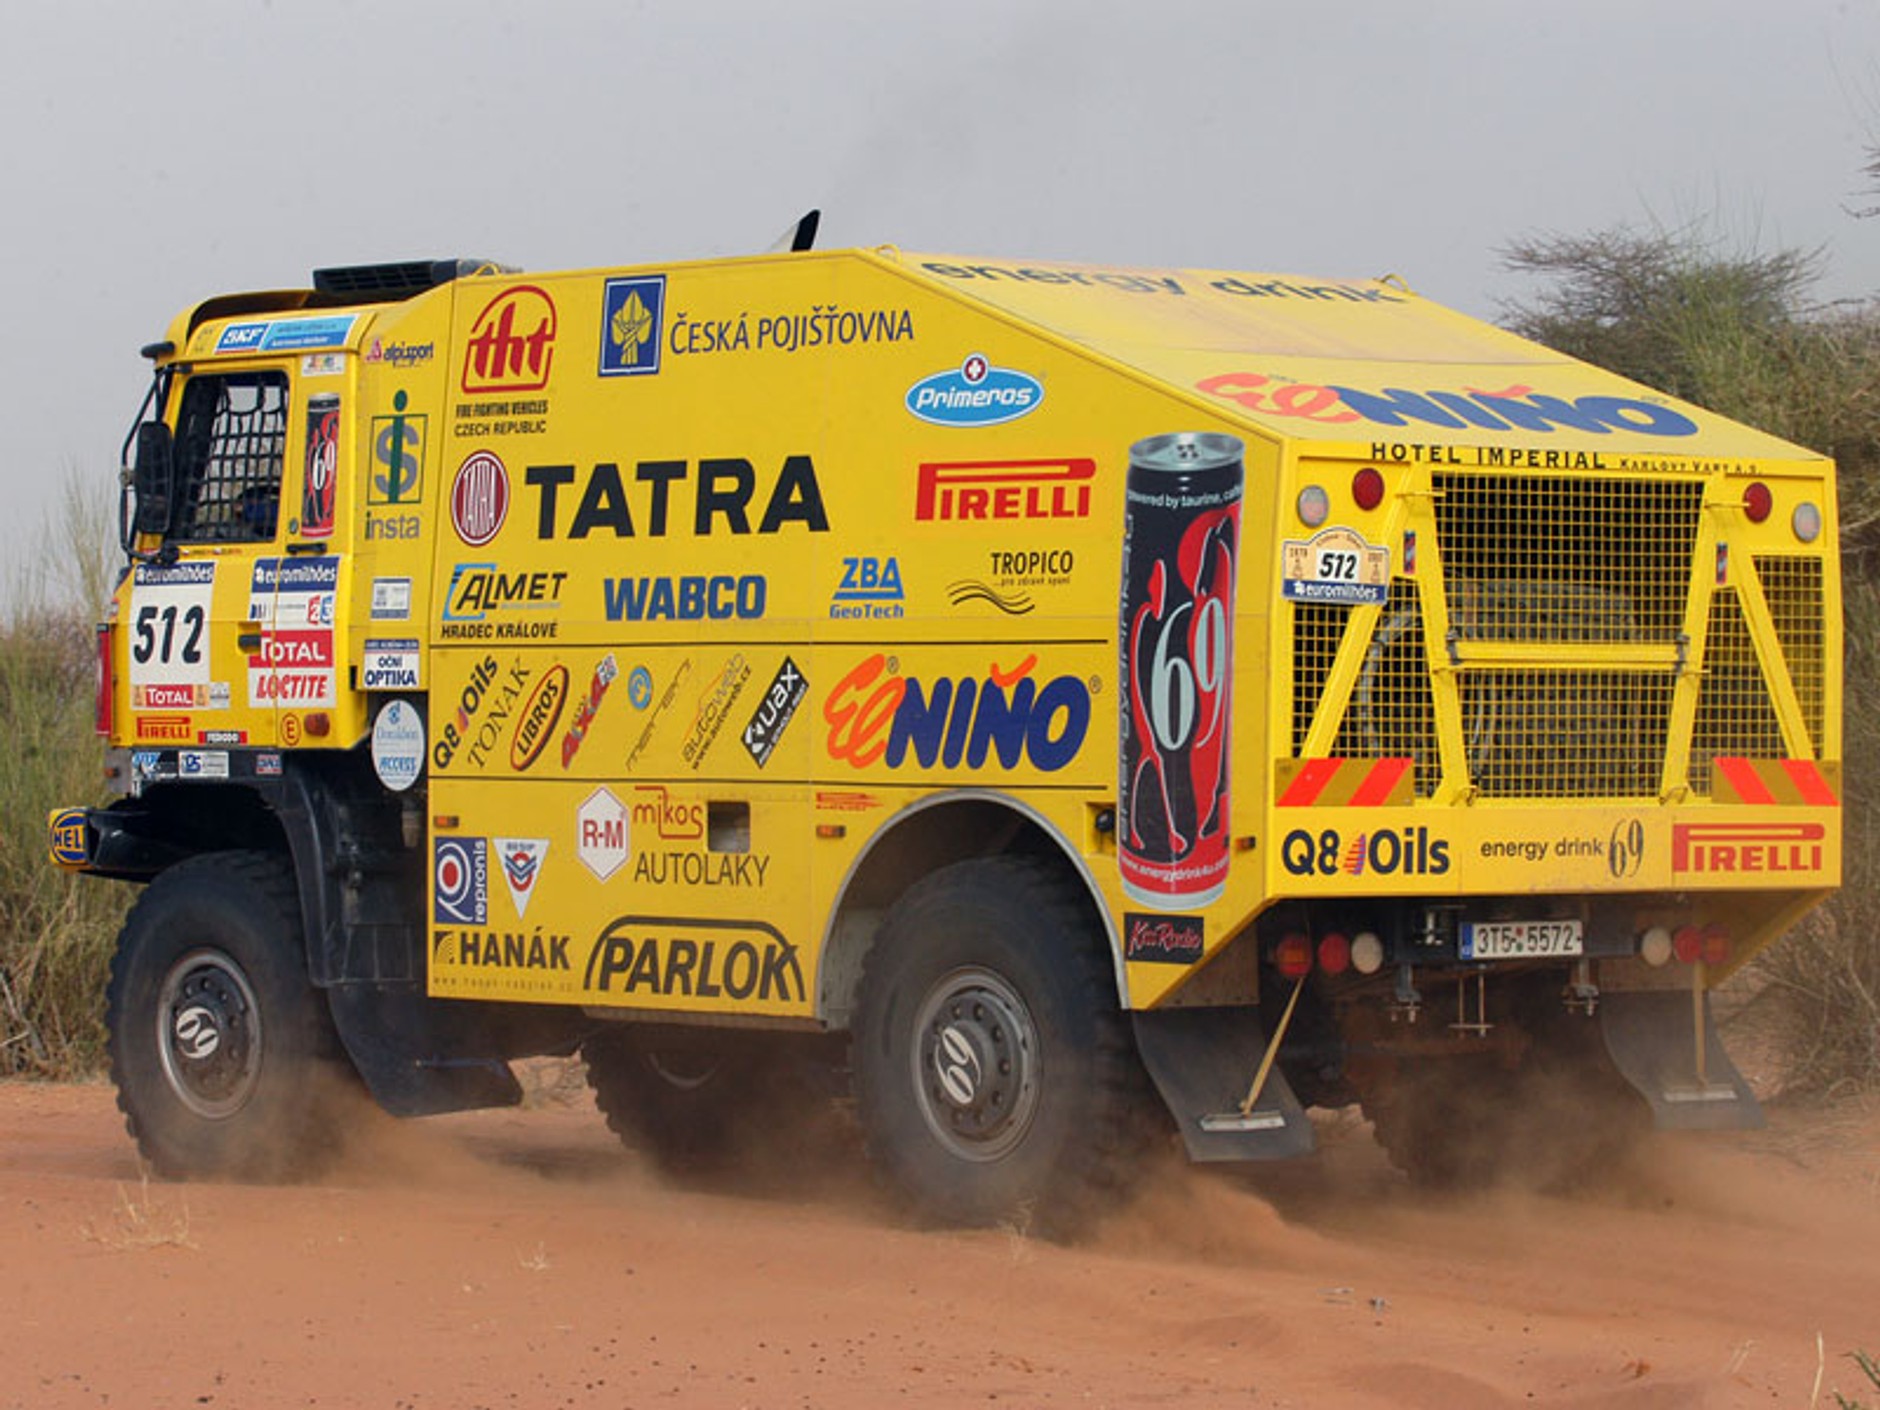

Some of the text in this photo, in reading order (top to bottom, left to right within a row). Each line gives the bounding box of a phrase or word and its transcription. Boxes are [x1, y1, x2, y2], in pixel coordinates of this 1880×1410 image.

[921, 263, 1408, 303] energy drink
[223, 328, 264, 345] SKF
[669, 305, 914, 354] ČESKÁ POJIŠŤOVNA
[916, 384, 1034, 410] Primeros
[454, 419, 547, 438] CZECH REPUBLIC
[1371, 442, 1461, 465] HOTEL
[1477, 445, 1606, 471] IMPERIAL
[525, 454, 830, 540] TATRA
[915, 458, 1096, 521] PIRELLI
[365, 511, 420, 540] insta
[990, 550, 1073, 575] TROPICO
[1319, 551, 1358, 579] 512
[456, 572, 567, 610] ALMET
[603, 575, 767, 621] WABCO
[441, 618, 558, 639] HRADEC KRÁLOVÉ
[829, 602, 905, 620] GeoTech
[133, 604, 204, 664] 512
[261, 637, 327, 662] TOTAL
[256, 674, 328, 699] LOCTITE
[365, 669, 417, 686] OPTIKA
[1151, 597, 1226, 750] 69
[148, 688, 193, 704] TOTAL
[433, 654, 498, 770] Q8 Oils
[467, 657, 530, 768] TONAK
[136, 716, 191, 738] PIRELLI
[516, 679, 559, 756] LIBROS
[633, 786, 704, 840] mikos
[583, 819, 624, 849] R-M
[1281, 827, 1450, 876] Q8 Oils
[1480, 818, 1644, 878] energy drink 69
[1673, 823, 1825, 873] PIRELLI
[634, 852, 770, 887] AUTOLAKY
[460, 926, 571, 971] HANÁK
[1527, 925, 1574, 951] 5572
[598, 936, 798, 1003] PARLOK
